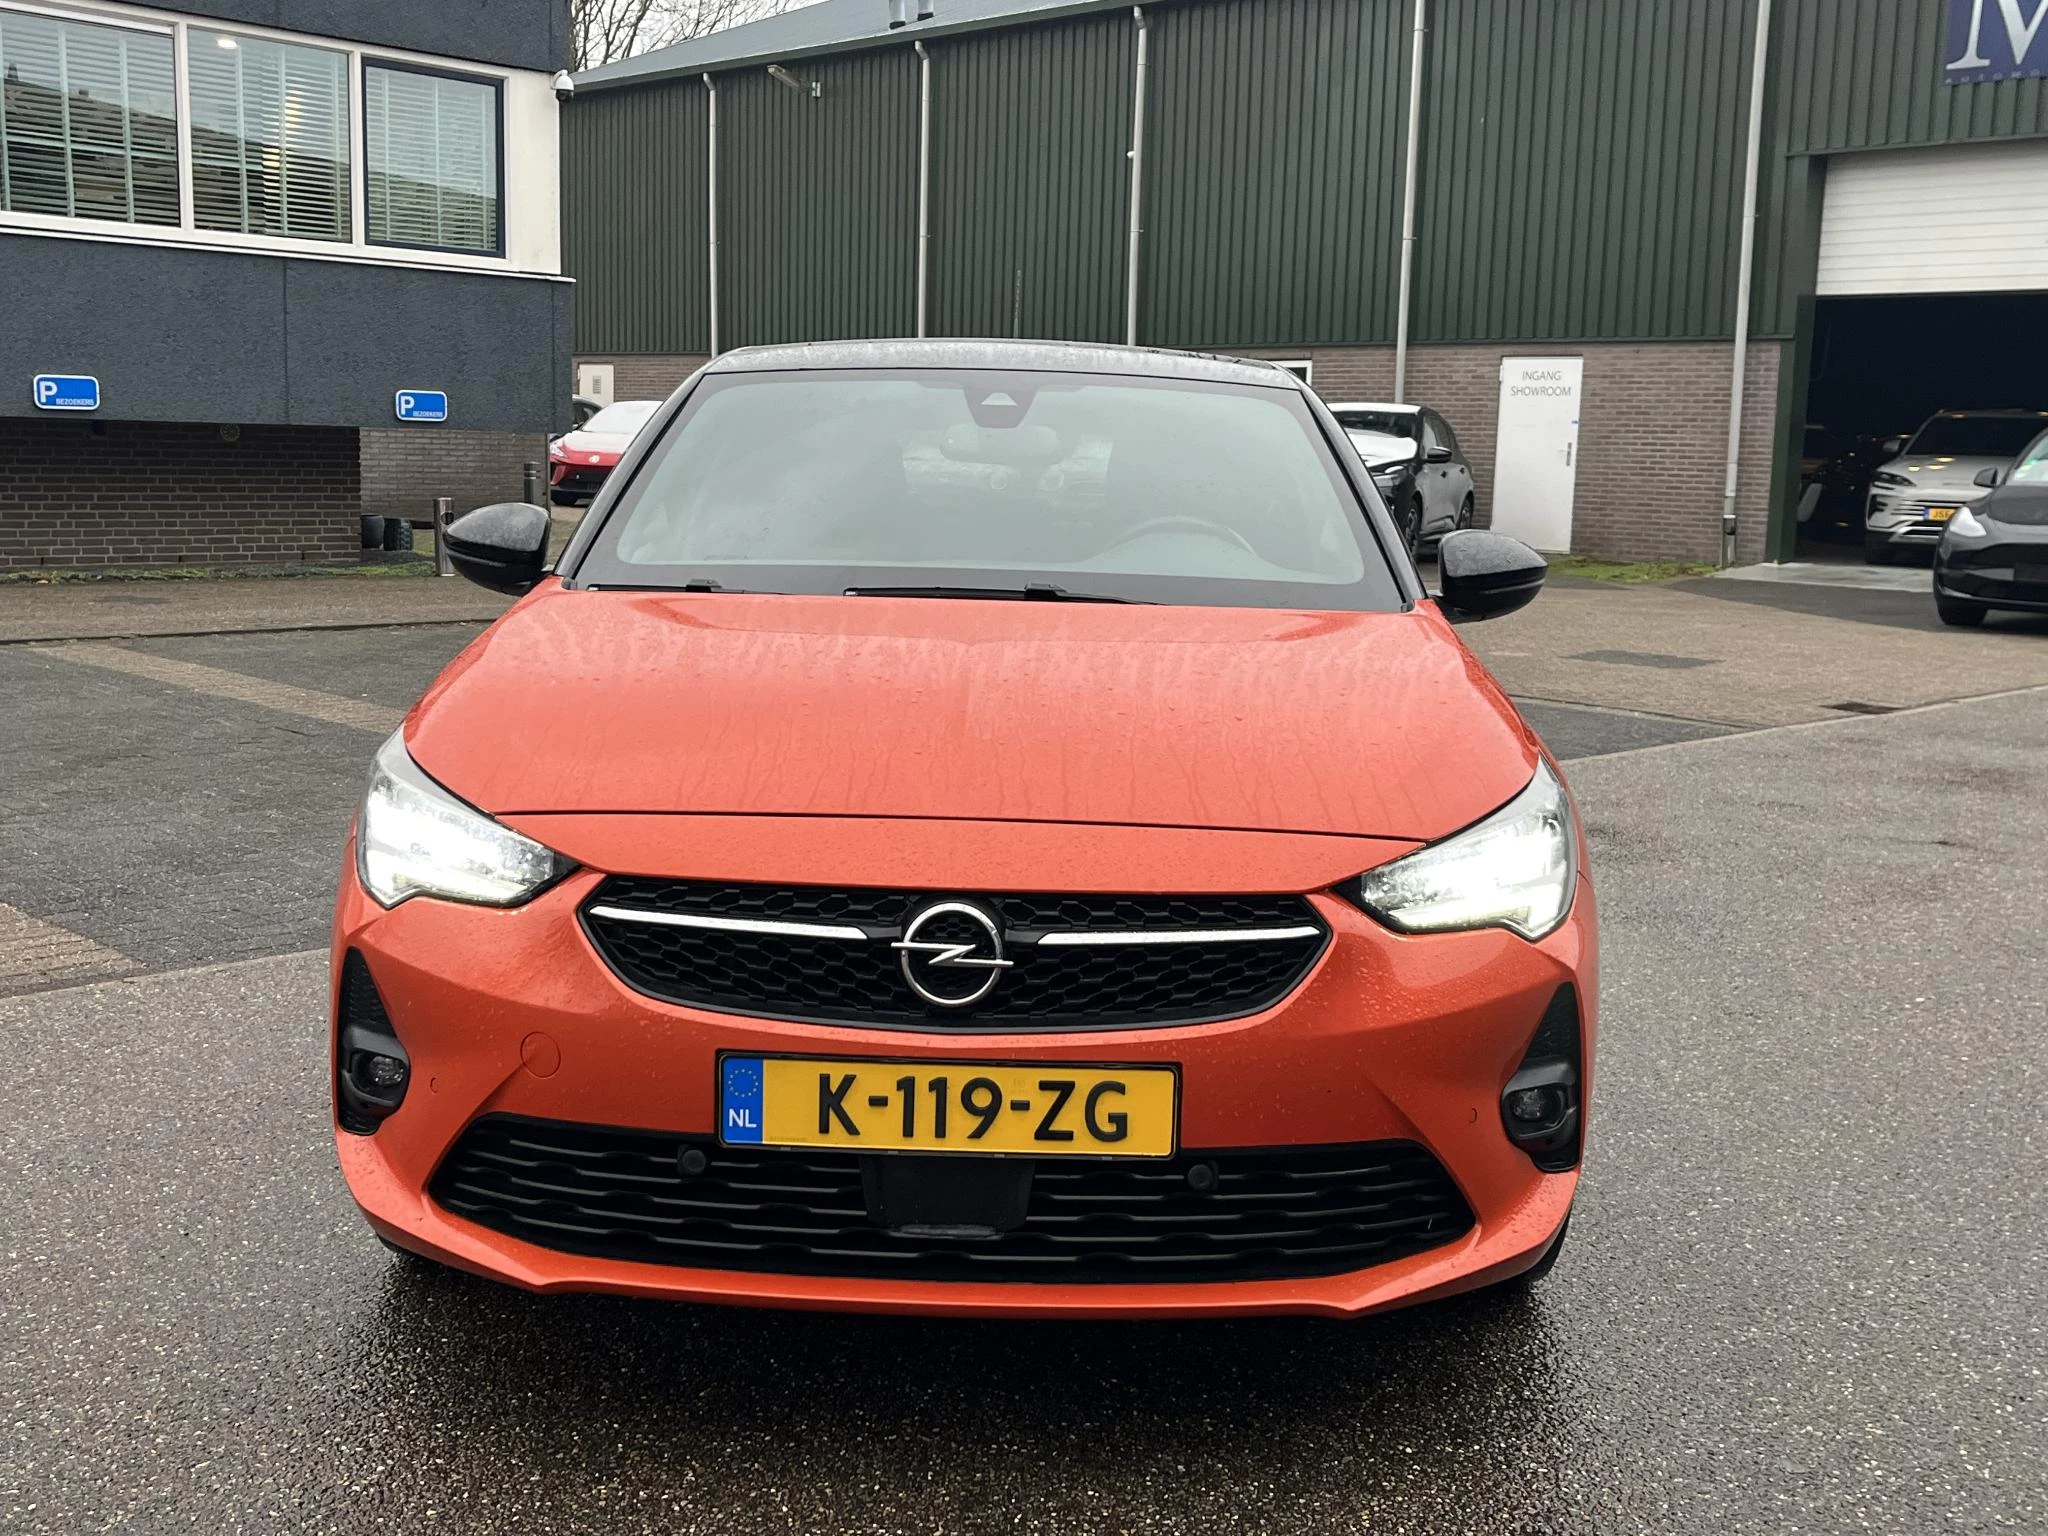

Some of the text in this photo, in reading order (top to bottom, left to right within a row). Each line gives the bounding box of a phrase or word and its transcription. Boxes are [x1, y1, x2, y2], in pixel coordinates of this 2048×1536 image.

[1522, 370, 1562, 381] INGANG
[39, 381, 58, 403] P
[1510, 386, 1571, 397] SHOWROOM
[400, 395, 415, 415] P
[728, 1108, 757, 1128] NL
[818, 1073, 1129, 1143] K-119-ZG
